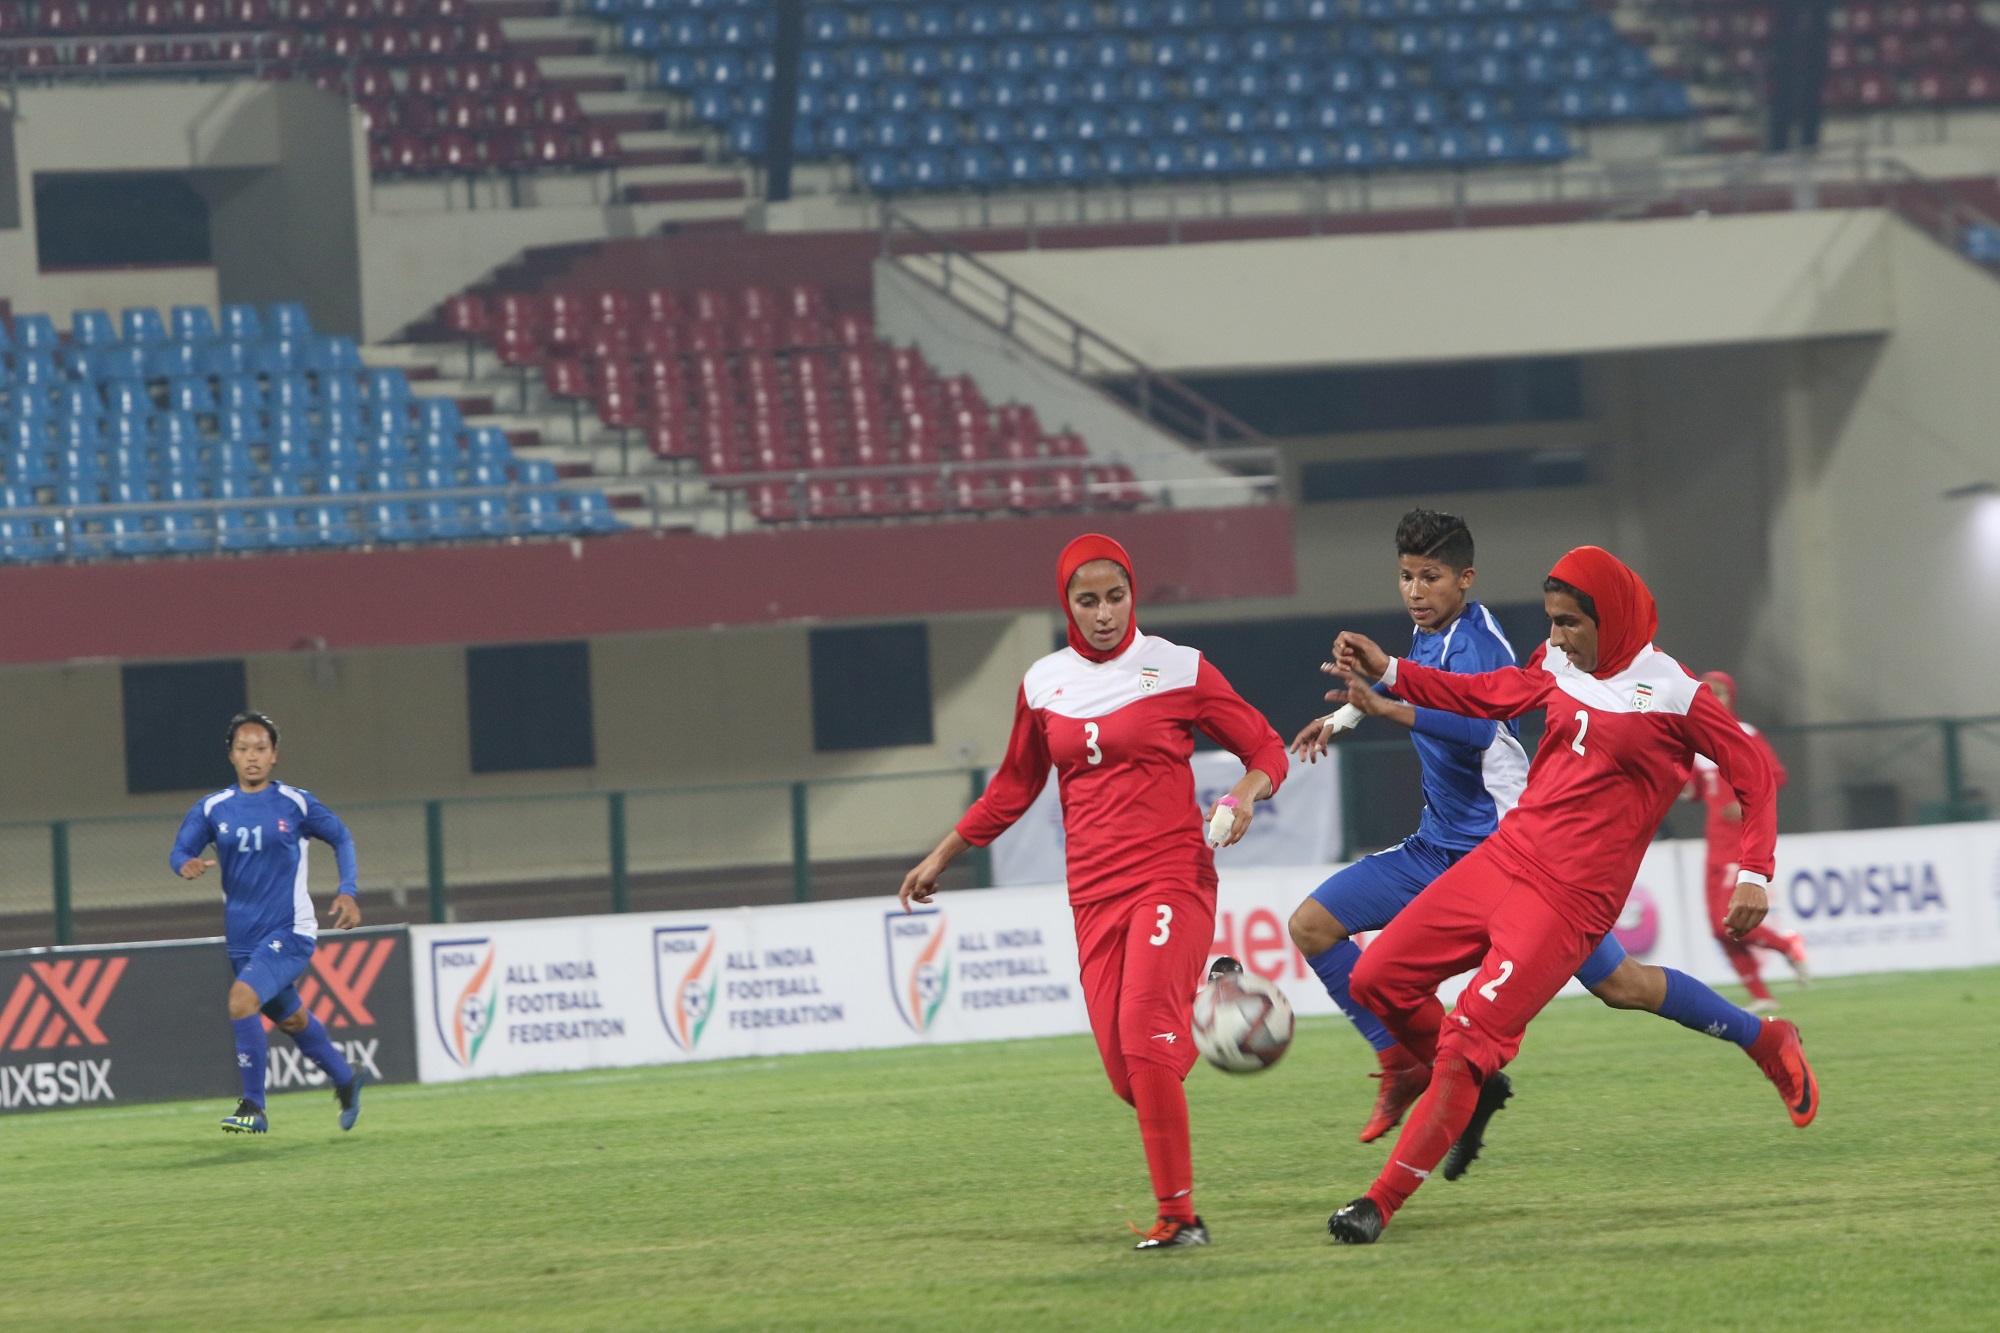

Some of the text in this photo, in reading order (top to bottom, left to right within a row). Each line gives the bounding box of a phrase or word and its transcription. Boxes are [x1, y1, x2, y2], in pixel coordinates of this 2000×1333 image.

[1084, 721, 1103, 766] 3
[1571, 709, 1590, 757] 2
[235, 824, 263, 853] 21
[1789, 862, 1948, 920] ODISHA
[894, 921, 929, 938] INDIA
[1148, 903, 1174, 947] 3
[662, 939, 698, 955] INDIA
[957, 928, 1043, 951] ALL INDIA
[441, 952, 477, 968] INDIA
[726, 946, 815, 970] ALL INDIA
[959, 956, 1049, 981] FOOTBALL
[505, 960, 597, 985] ALL INDIA
[1478, 959, 1514, 1003] 2
[727, 976, 822, 1000] FOOTBALL
[961, 984, 1071, 1010] FEDERATION
[506, 990, 603, 1015] FOOTBALL
[728, 1003, 845, 1030] FEDERATION
[508, 1018, 626, 1044] FEDERATION
[0, 1058, 115, 1108] IX5SIX
